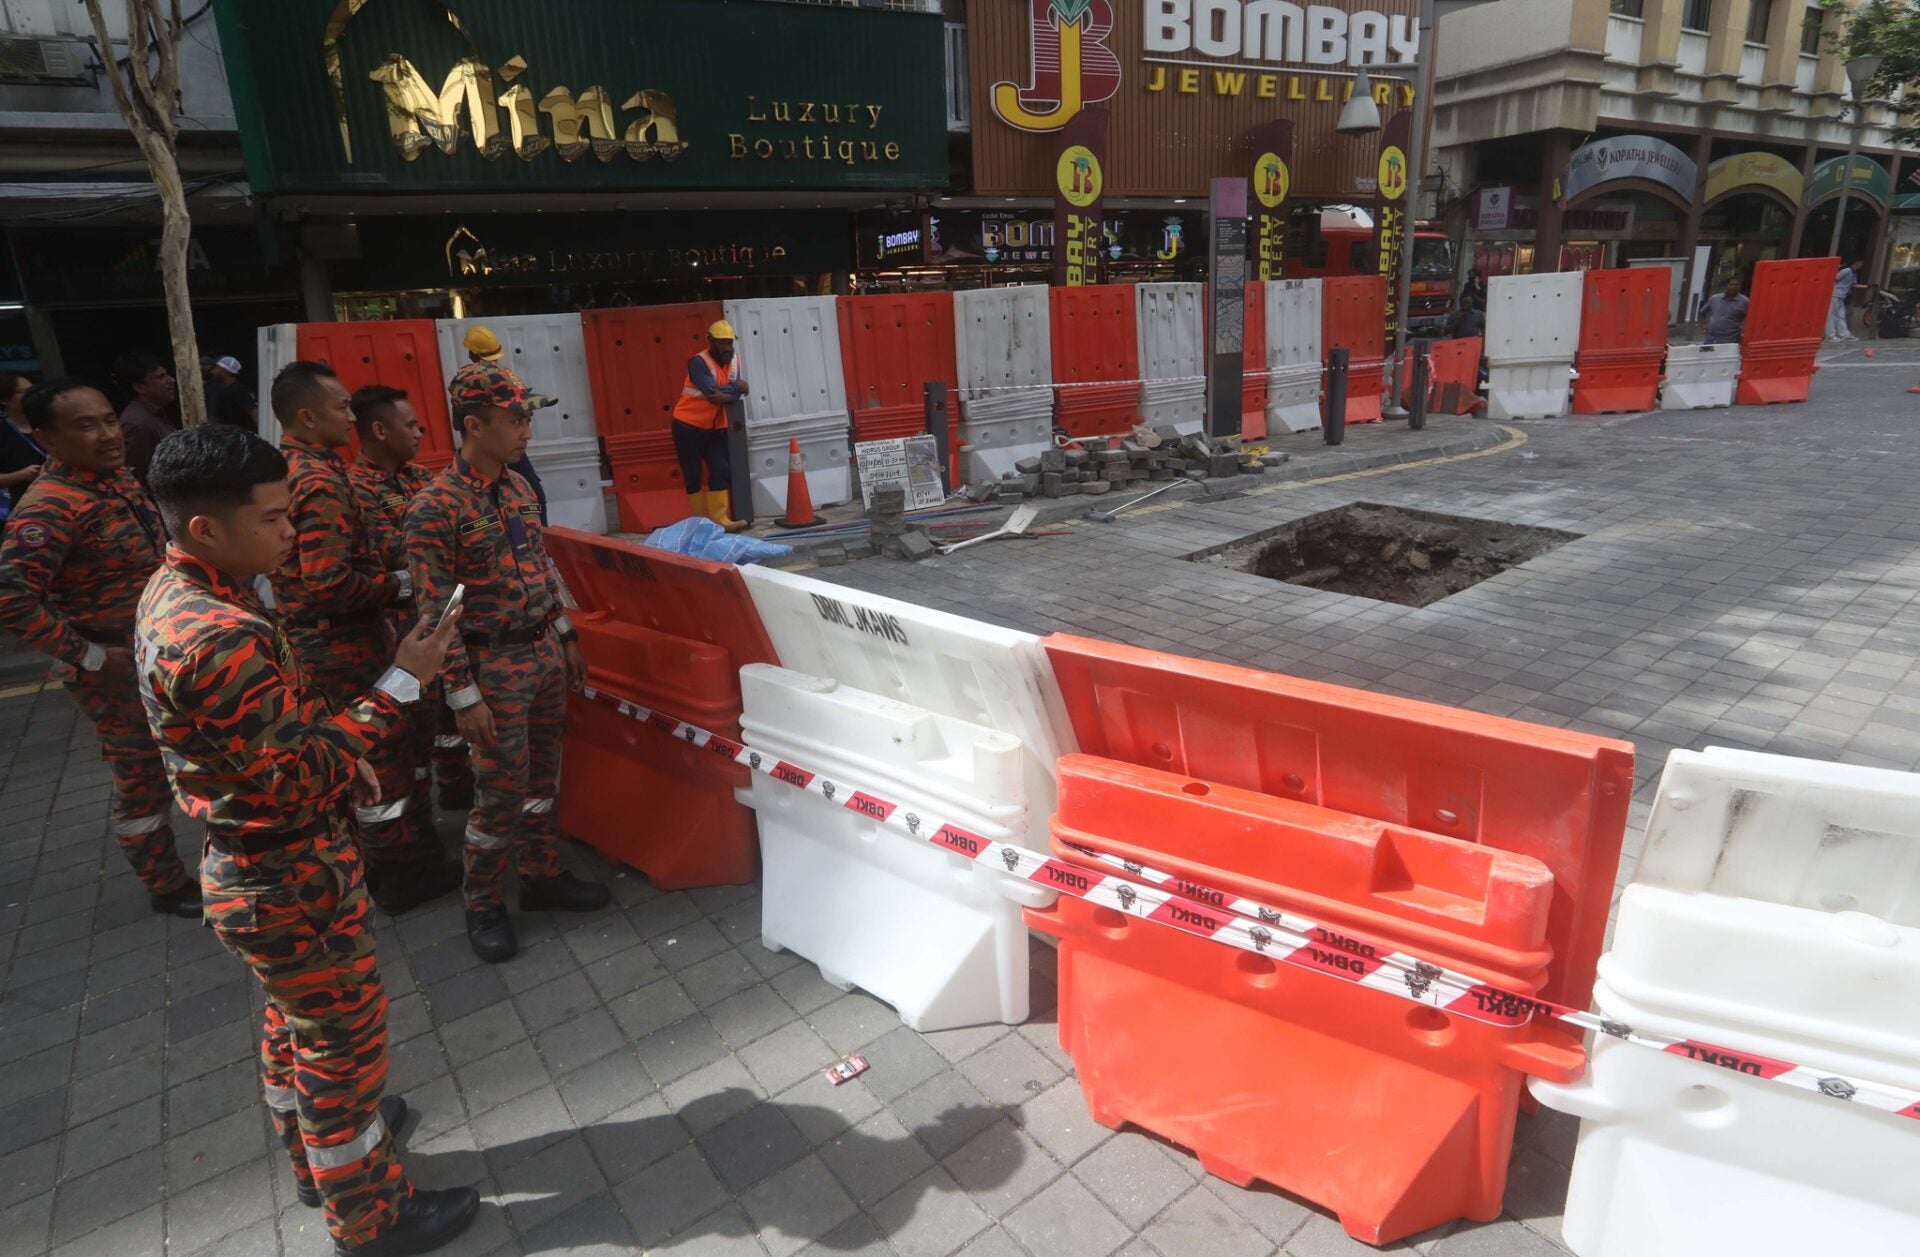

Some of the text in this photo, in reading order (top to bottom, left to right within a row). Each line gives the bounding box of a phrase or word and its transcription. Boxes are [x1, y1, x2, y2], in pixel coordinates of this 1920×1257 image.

[1143, 0, 1420, 67] BOMBAY
[369, 53, 690, 162] Mina
[745, 95, 883, 129] Luxury
[728, 133, 901, 165] Boutique
[886, 230, 919, 248] BOMBAY
[1066, 214, 1084, 287] BAY
[1086, 217, 1098, 284] LERY
[1259, 214, 1272, 280] BAY
[1272, 217, 1285, 276] LERY
[671, 243, 786, 269] Boutique
[809, 591, 910, 646] DBKL JKAWS
[777, 765, 804, 786] DBKL
[853, 796, 885, 818] DBKL
[941, 829, 978, 854] DBKL
[1046, 864, 1088, 891] DBKL
[1166, 904, 1216, 931] DBKL
[1317, 927, 1375, 958] DBKL
[1307, 947, 1365, 975] DBKL
